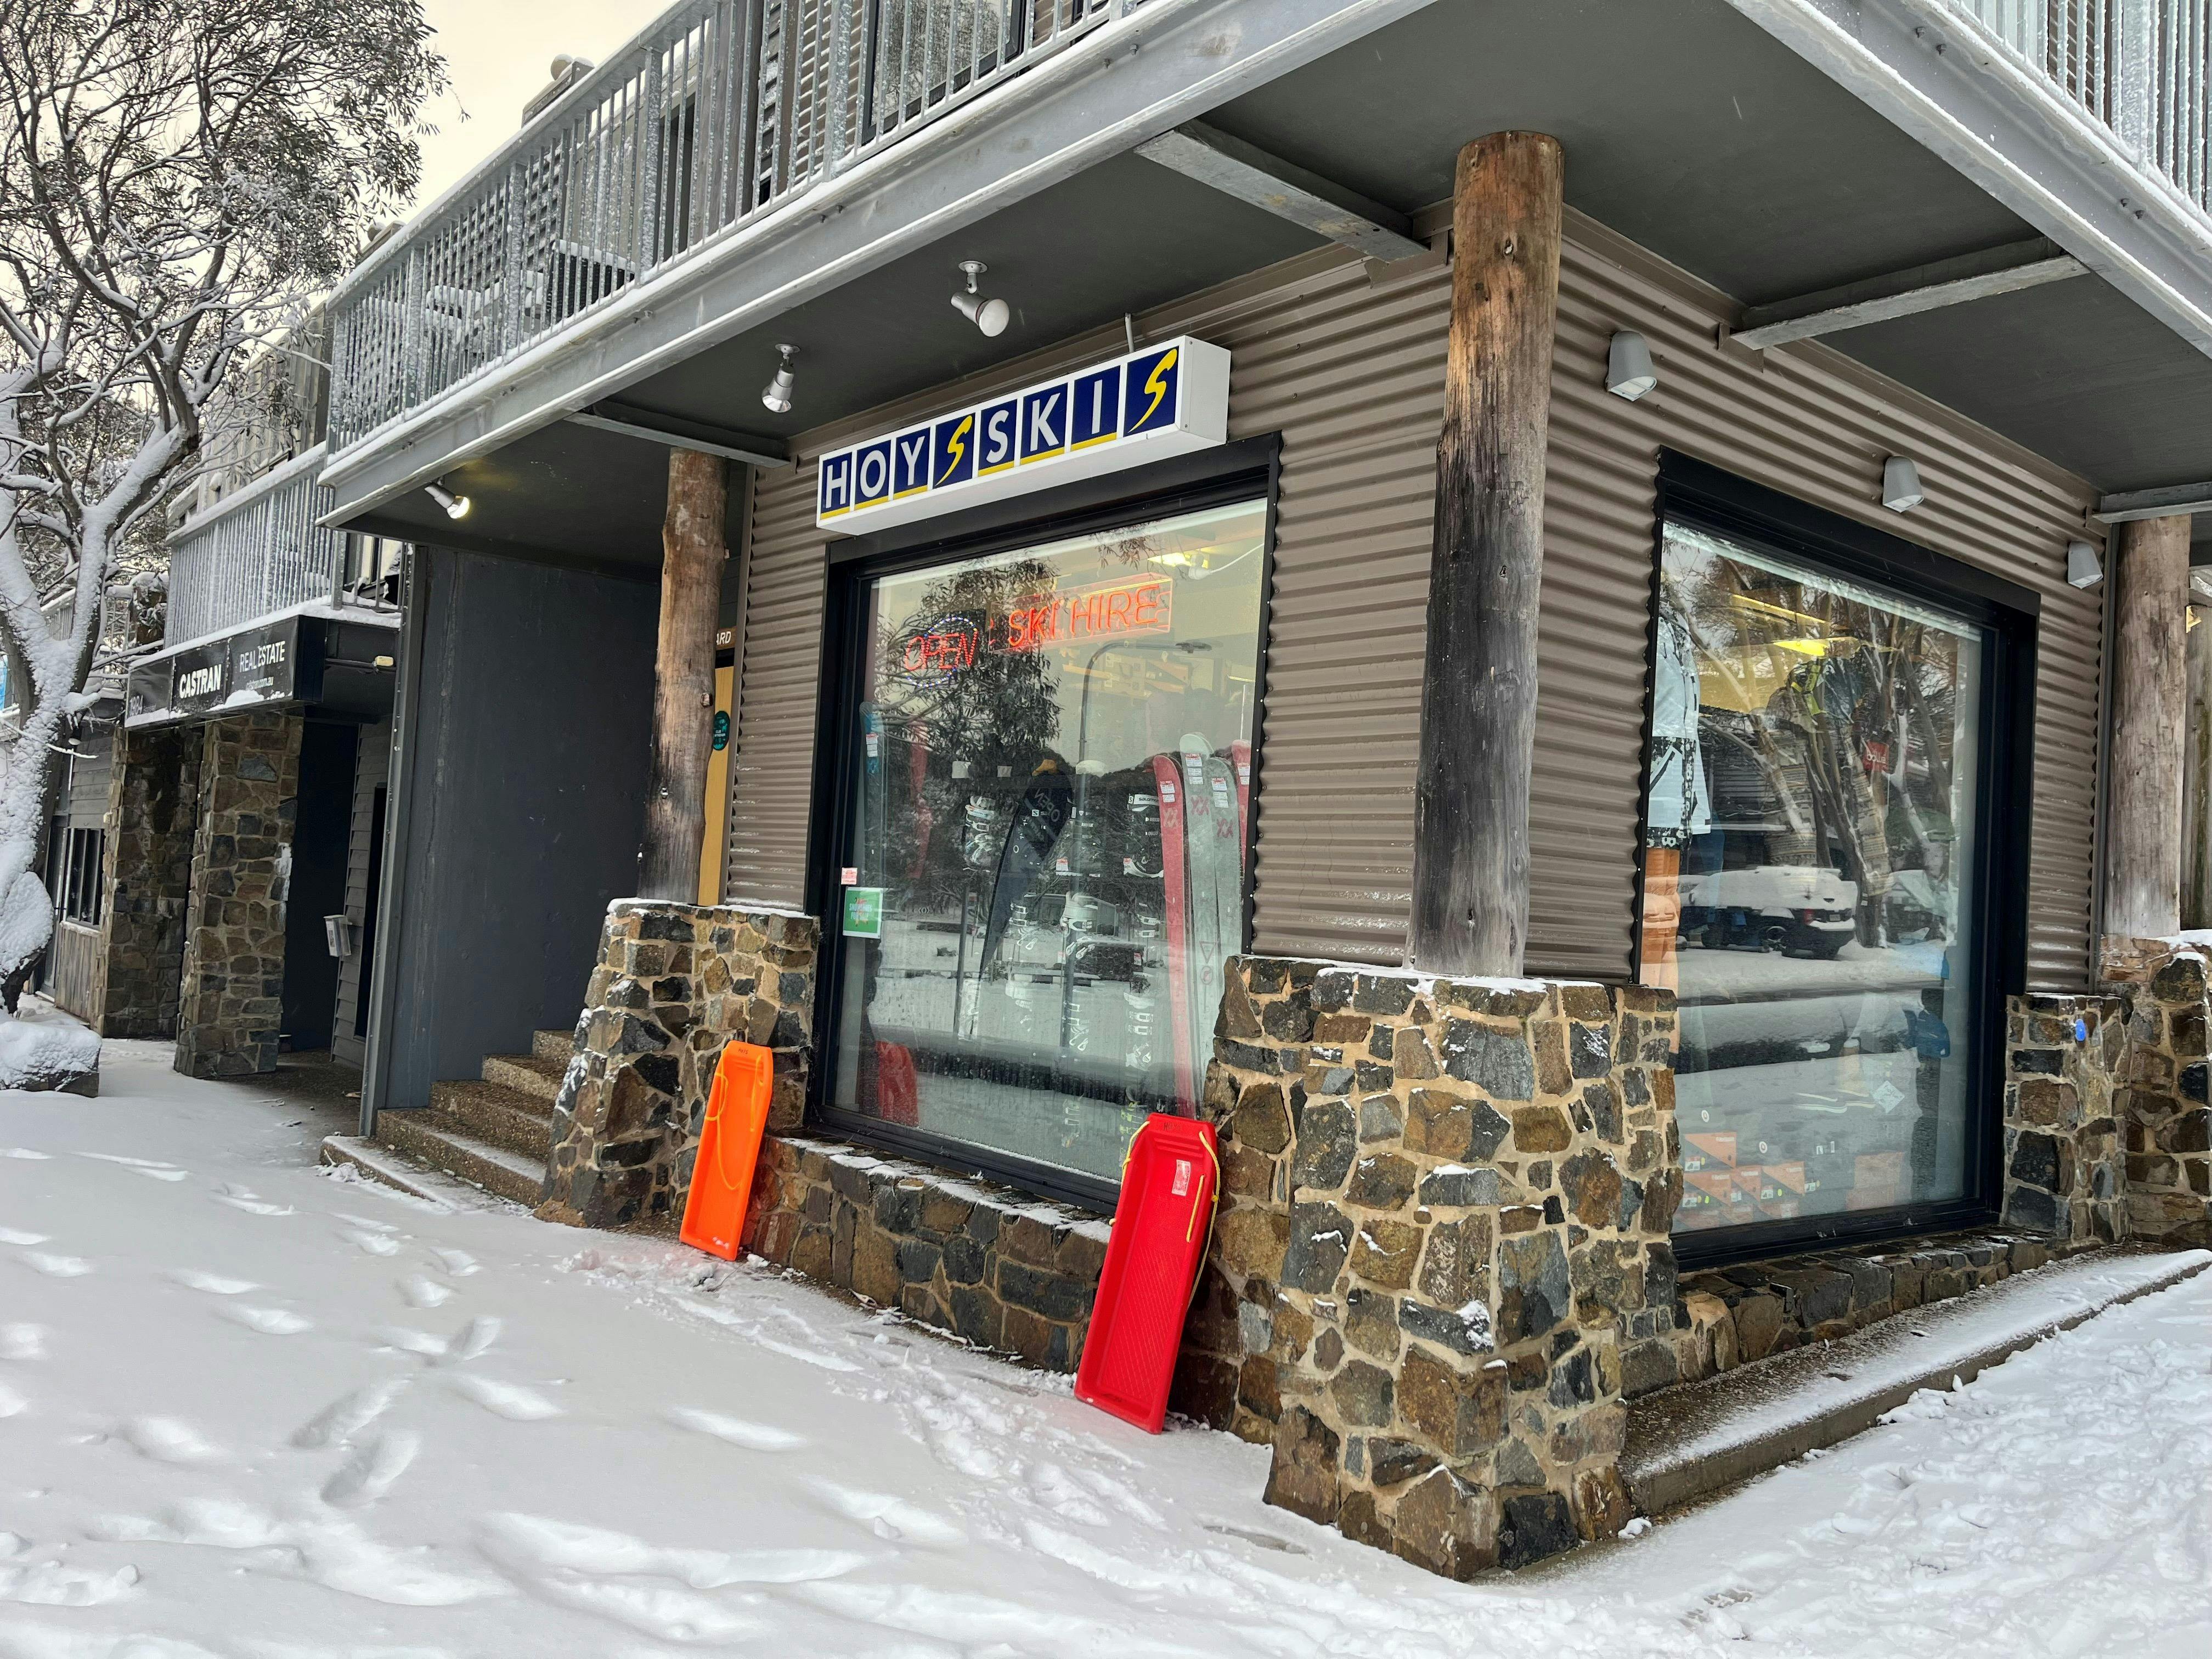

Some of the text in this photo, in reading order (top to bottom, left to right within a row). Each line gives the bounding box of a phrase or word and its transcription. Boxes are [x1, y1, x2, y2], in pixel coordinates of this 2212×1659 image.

[826, 348, 1178, 509] HOYS SKIS
[1007, 584, 1160, 646] SKI HIRE
[239, 640, 286, 673] REAL ESTATE
[904, 630, 979, 671] OPEN
[179, 664, 222, 699] CASTRAN
[129, 694, 144, 716] 1984
